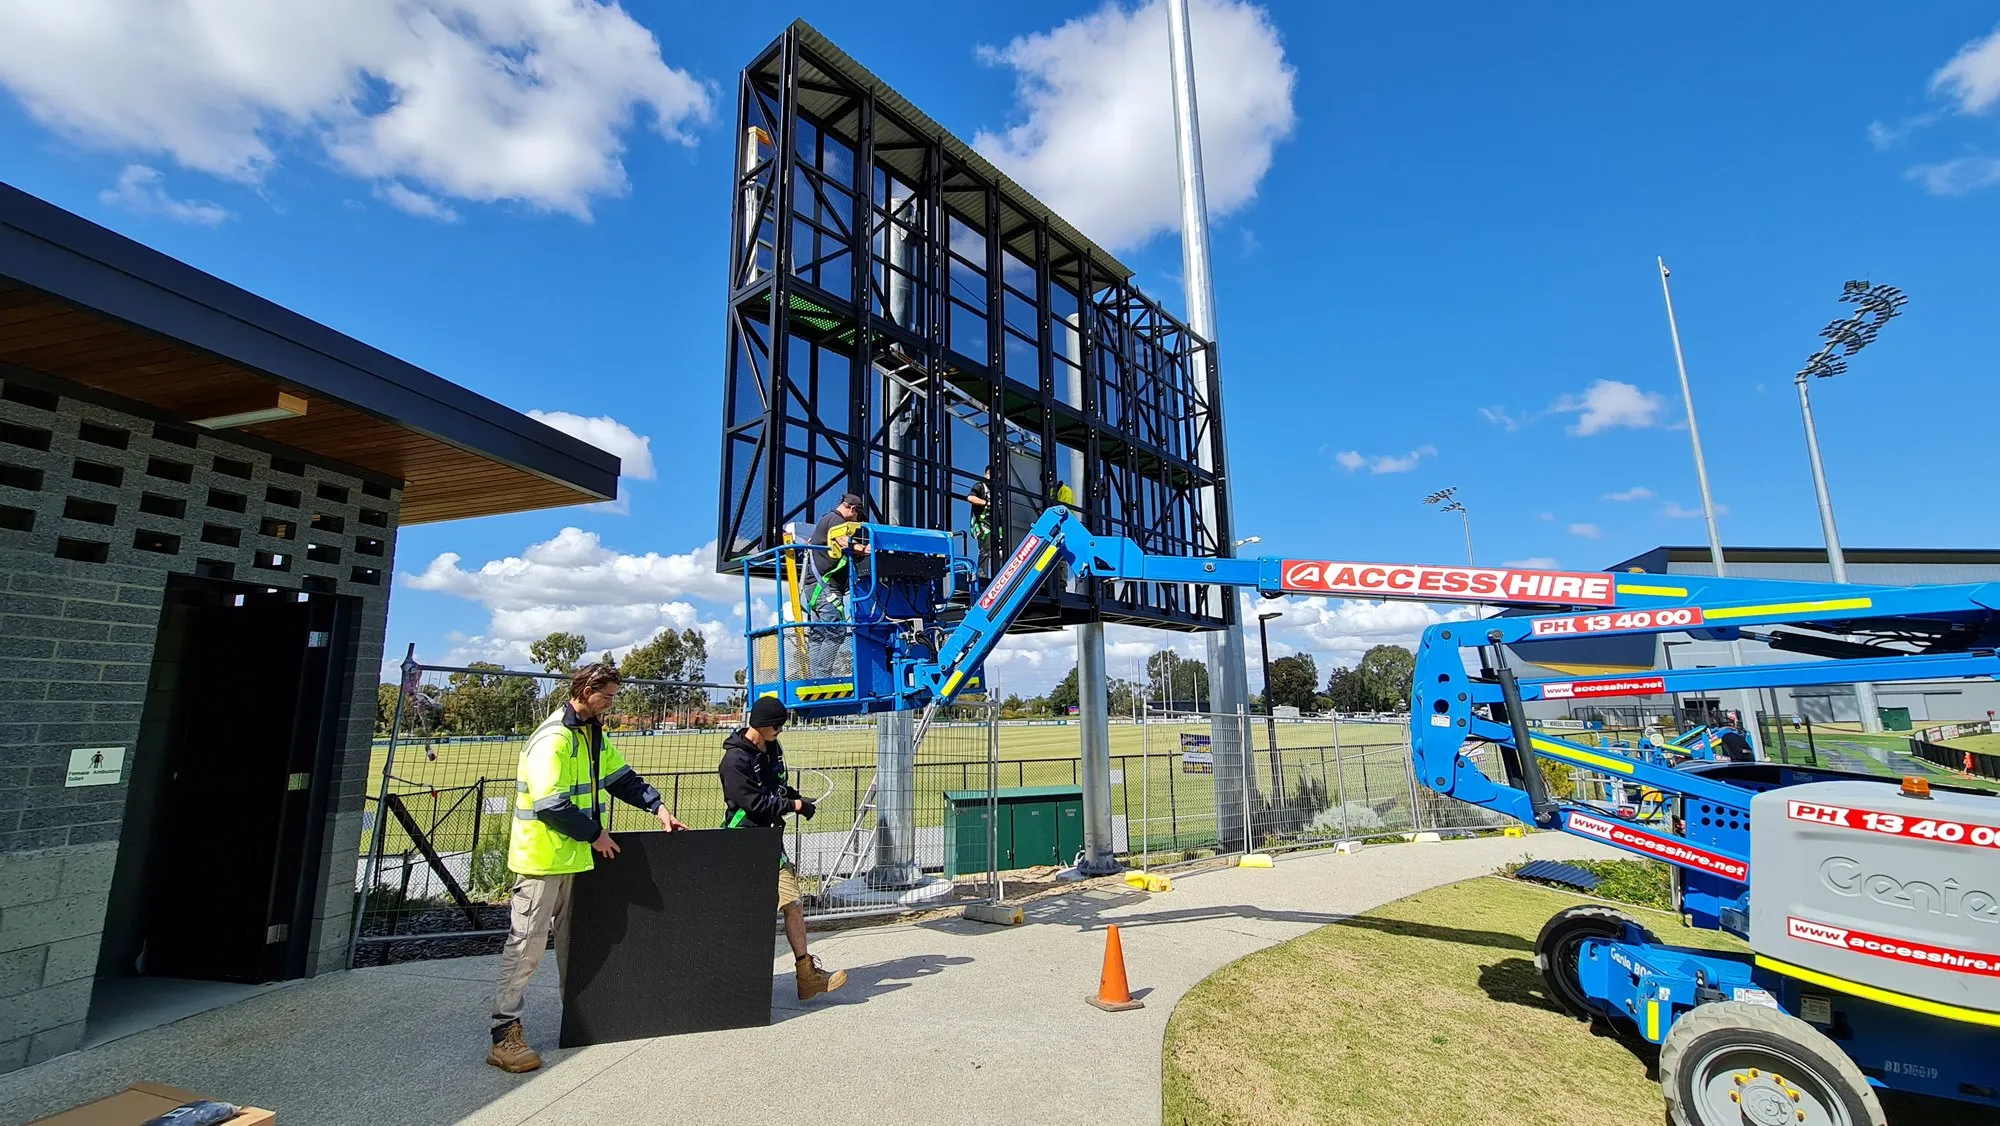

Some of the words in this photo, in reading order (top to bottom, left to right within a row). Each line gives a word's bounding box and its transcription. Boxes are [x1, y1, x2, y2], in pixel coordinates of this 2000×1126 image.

[990, 560, 1020, 598] ACCESS
[1017, 535, 1038, 562] HIRE
[1331, 567, 1498, 594] ACCESS
[1508, 573, 1610, 600] HIRE
[1540, 620, 1568, 633] PH
[1584, 616, 1611, 631] 13
[1616, 613, 1651, 628] 40
[1656, 610, 1692, 625] 00
[1574, 681, 1663, 693] accesshire.net
[1797, 805, 1838, 822] PH
[1862, 813, 1905, 833] 13
[1909, 820, 1965, 841] 40
[1574, 817, 1608, 833] www
[1613, 830, 1745, 877] accesshire.net
[1819, 856, 2000, 924] Genie
[1794, 923, 1841, 941] www
